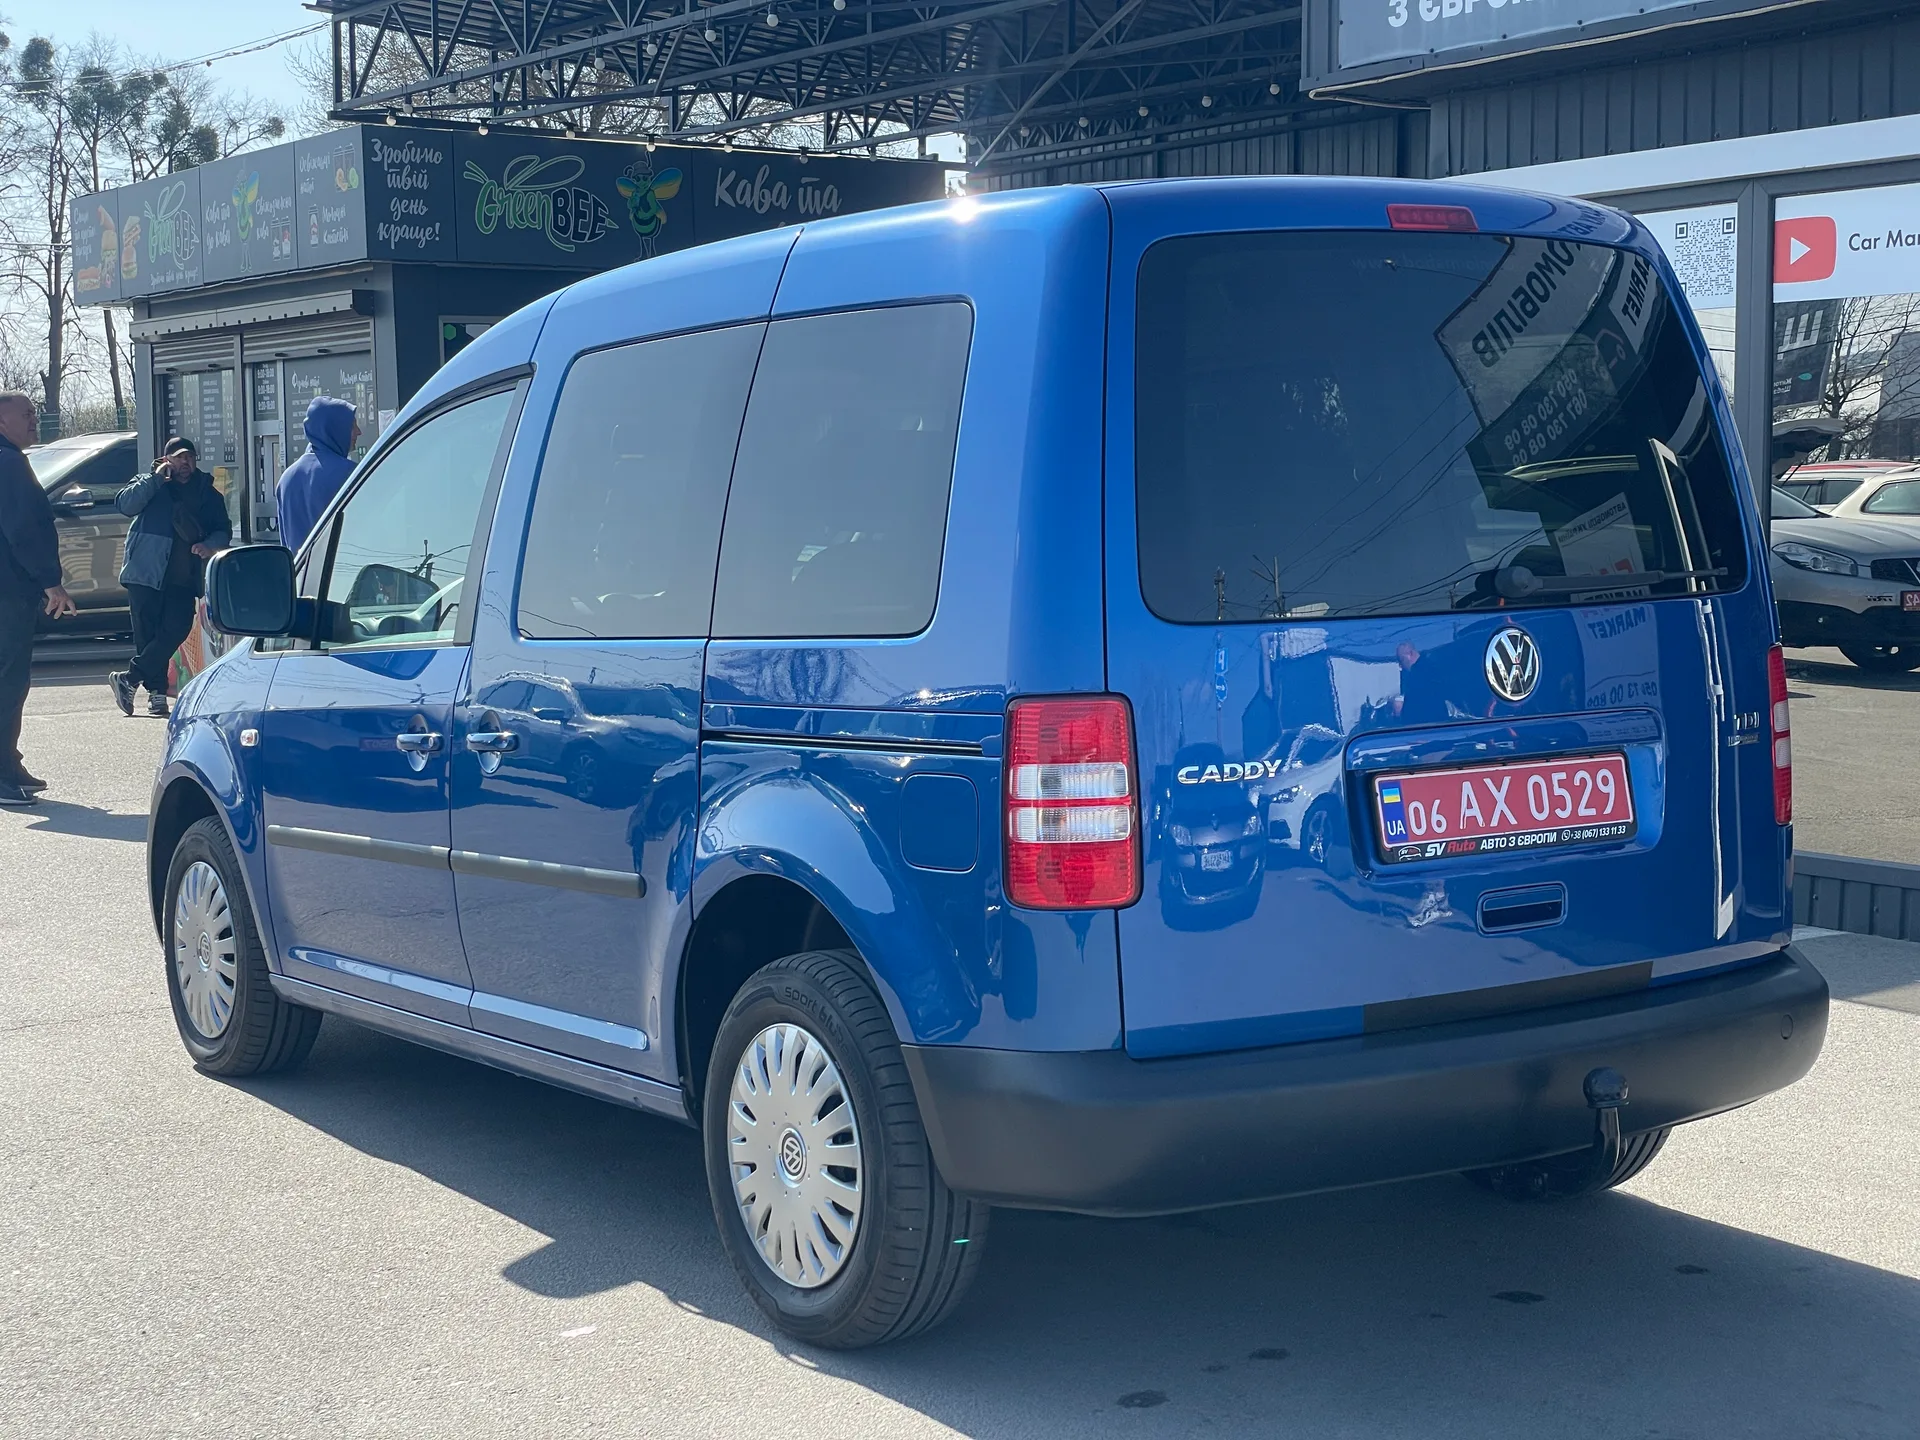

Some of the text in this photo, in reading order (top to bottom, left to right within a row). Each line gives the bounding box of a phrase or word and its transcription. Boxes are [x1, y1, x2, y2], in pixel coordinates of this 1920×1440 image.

[371, 138, 443, 171] Зробимо
[387, 165, 429, 190] твій
[715, 164, 842, 215] Кава та
[390, 197, 428, 221] день
[377, 222, 440, 249] краще!
[1849, 233, 1880, 251] Car
[1177, 759, 1282, 784] CADDY
[1408, 768, 1616, 836] 06 AX 0529
[1386, 820, 1406, 836] UA
[1424, 842, 1446, 858] SV
[1447, 840, 1476, 853] Auto
[1480, 837, 1507, 851] АВТО
[1517, 831, 1557, 846] ЄВРОПИ
